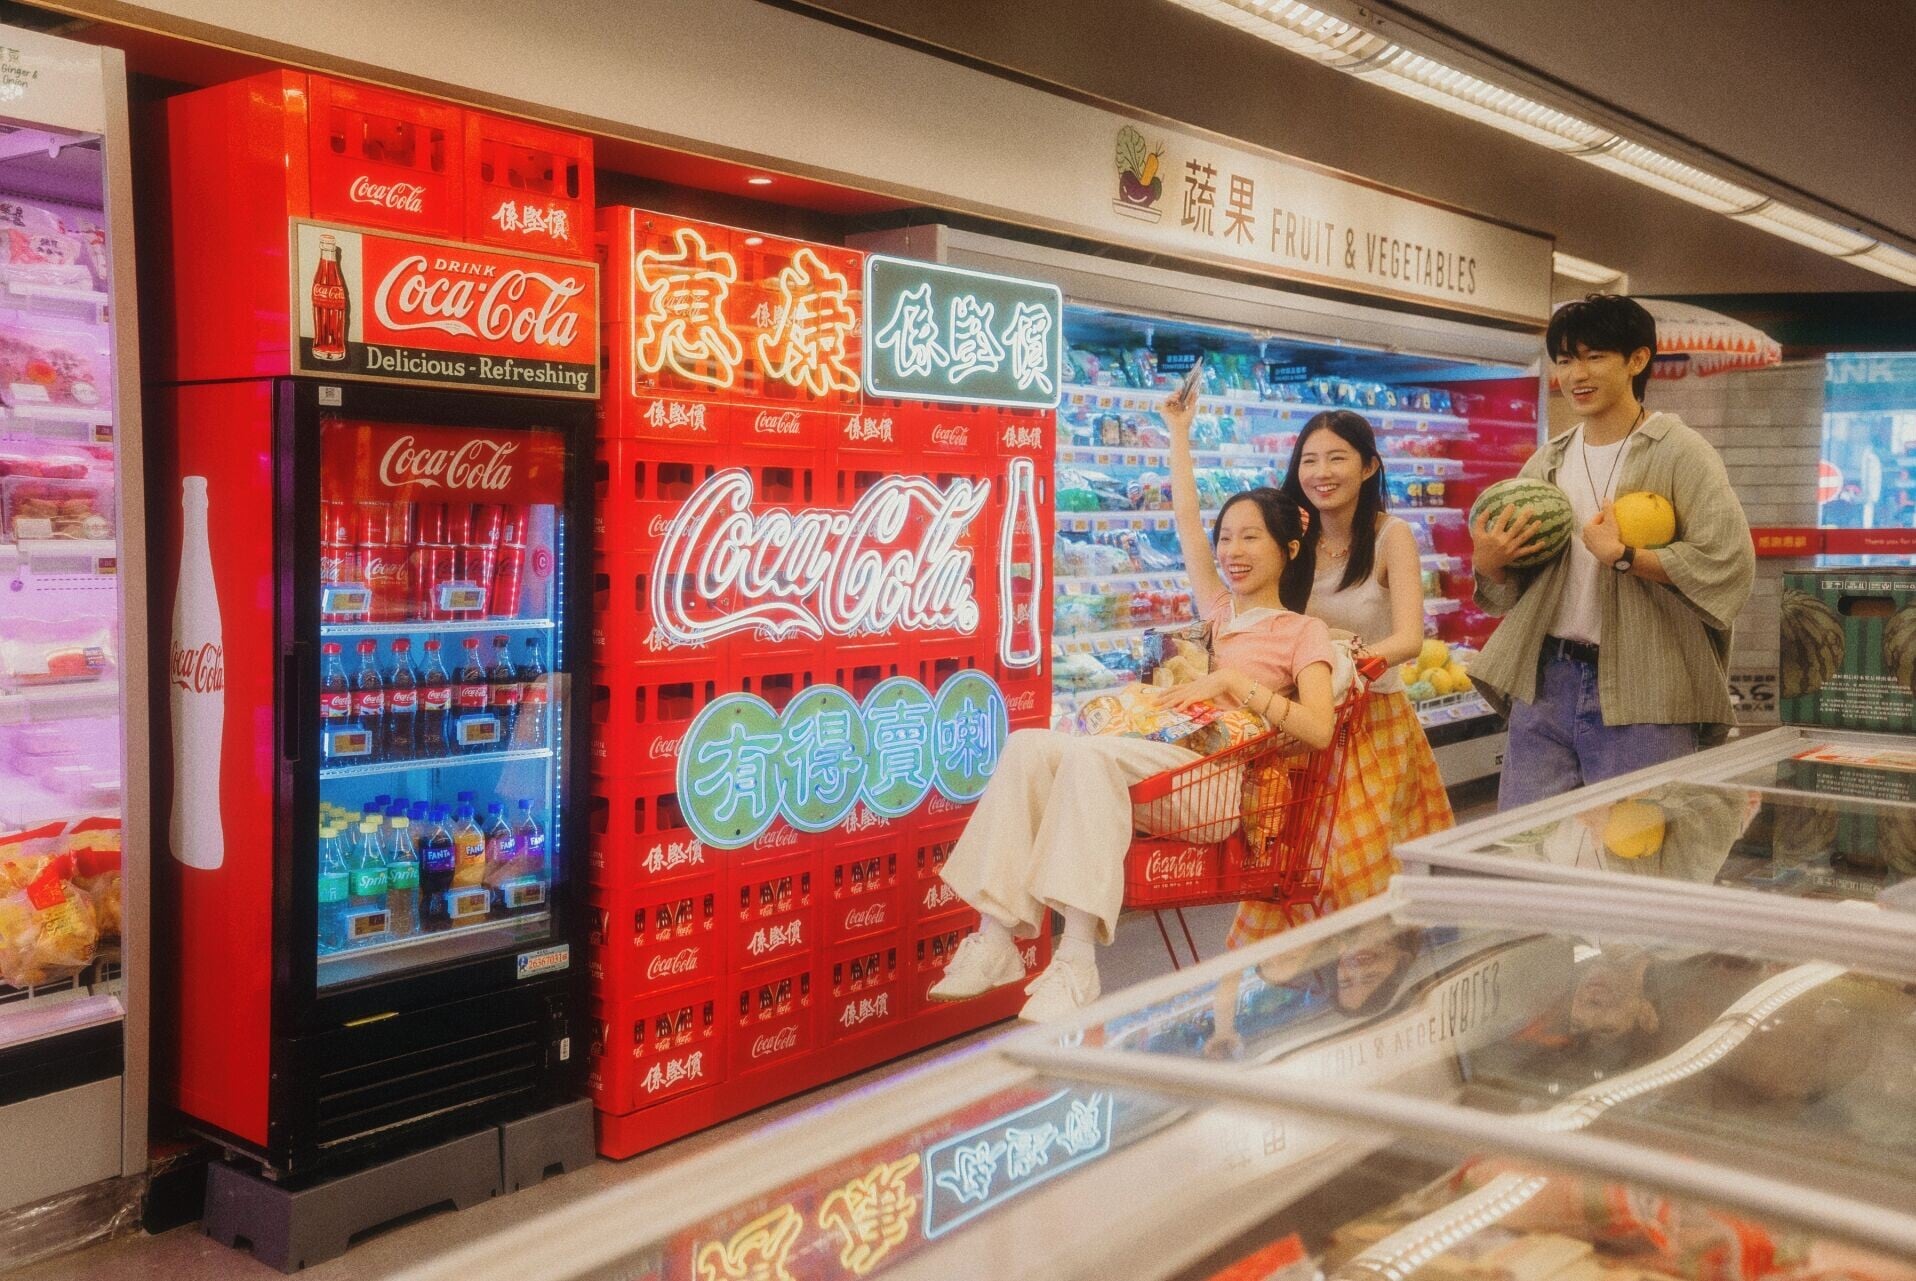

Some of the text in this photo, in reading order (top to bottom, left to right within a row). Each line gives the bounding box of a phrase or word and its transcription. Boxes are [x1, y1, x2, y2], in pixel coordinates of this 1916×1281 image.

[350, 175, 427, 213] Coca-Cola
[1181, 159, 1255, 244] 蔬果
[434, 258, 497, 277] DRINK
[1271, 208, 1477, 295] FRUIT & VEGETABLES
[374, 255, 586, 347] Coca-Cola
[366, 347, 466, 376] Delicious
[480, 357, 588, 391] Refreshing
[755, 410, 802, 434] Coca-Cola
[931, 424, 970, 446] Coca-Cola
[379, 435, 520, 490] Coca-Cola
[652, 467, 990, 642] Coca-Cola
[845, 903, 887, 930] Coca-Cola
[647, 946, 701, 980] Coca-Cola
[752, 1024, 799, 1058] Coca-Cola
